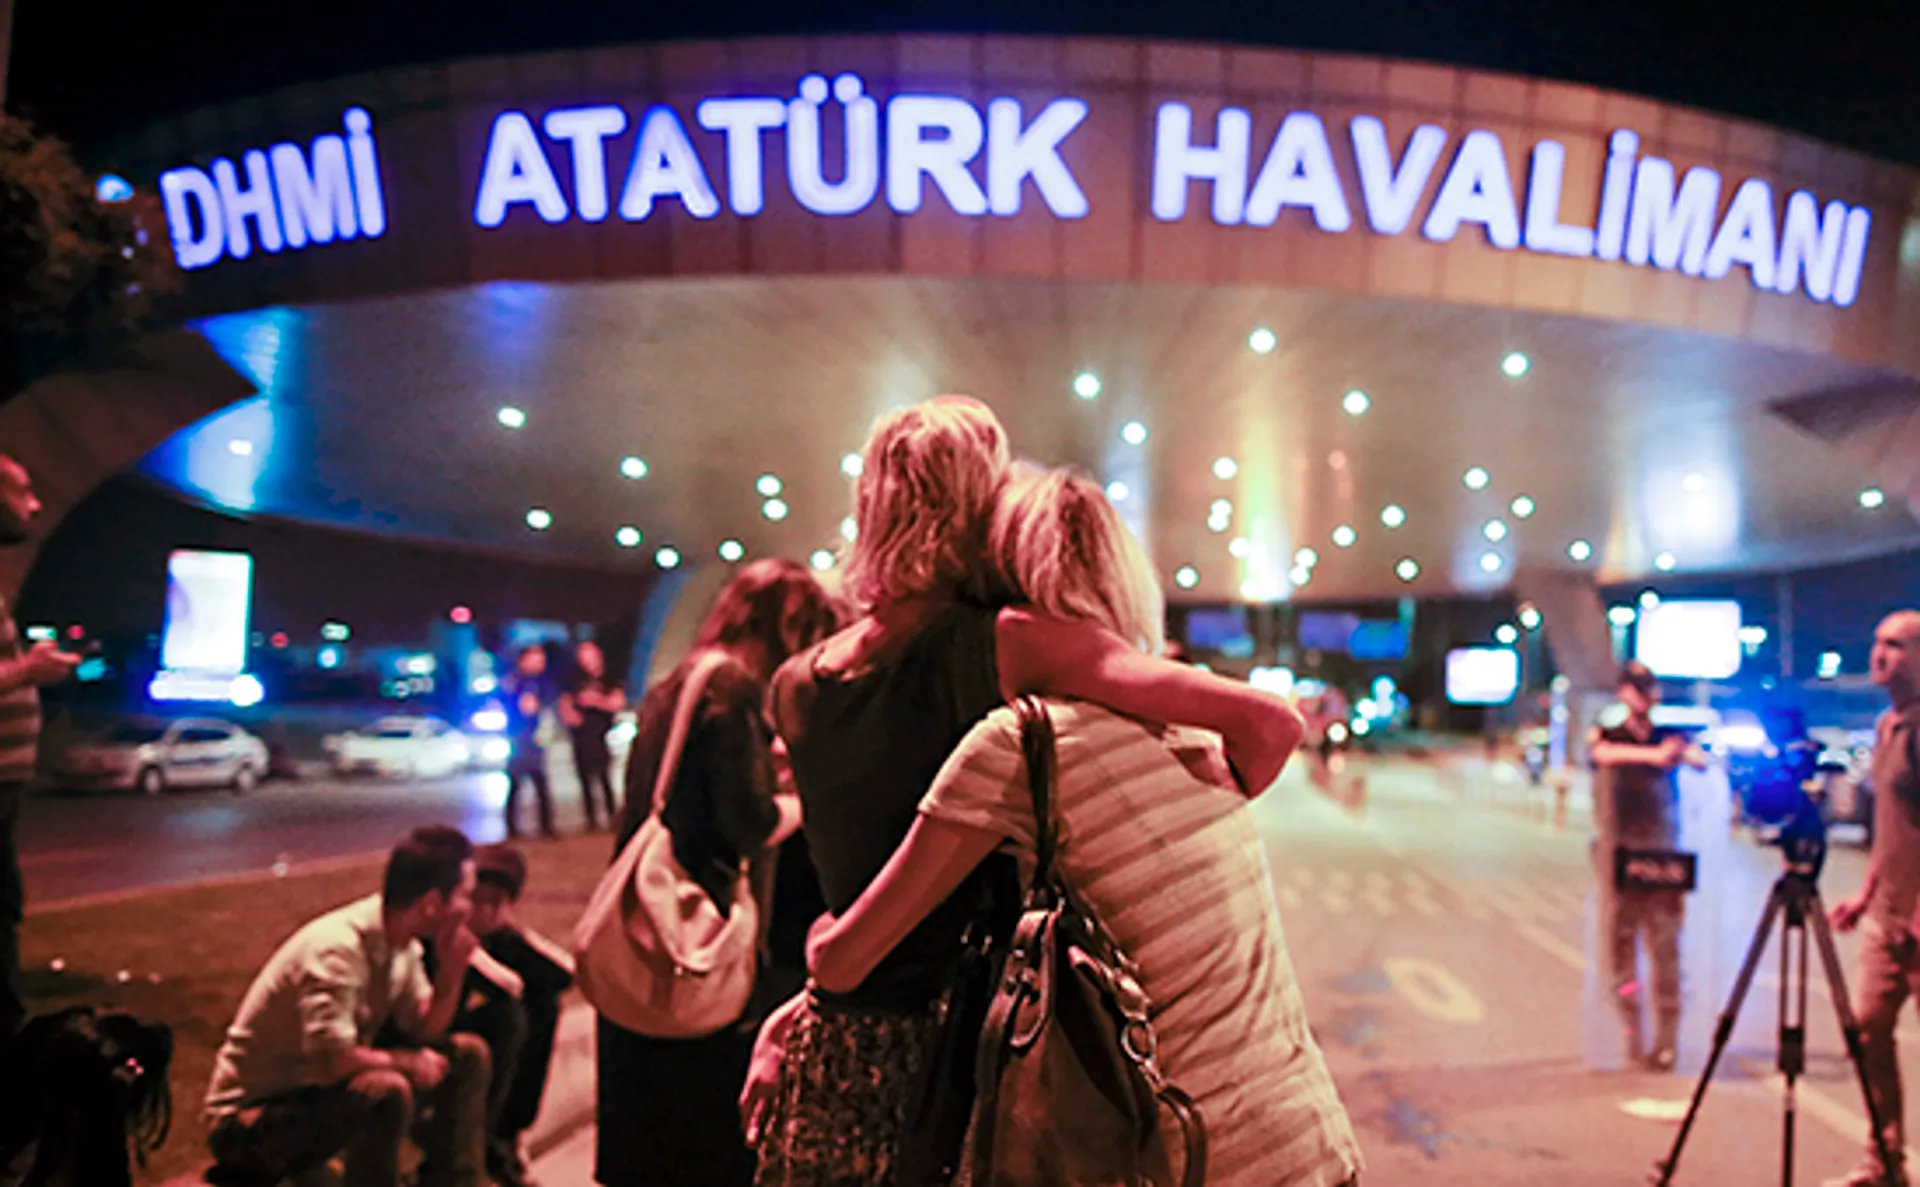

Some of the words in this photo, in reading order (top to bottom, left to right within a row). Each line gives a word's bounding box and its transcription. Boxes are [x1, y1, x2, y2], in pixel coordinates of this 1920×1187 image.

[161, 106, 385, 269] DHMİ
[474, 73, 1089, 226] ATATÜRK
[1152, 103, 1871, 306] HAVALİMANI
